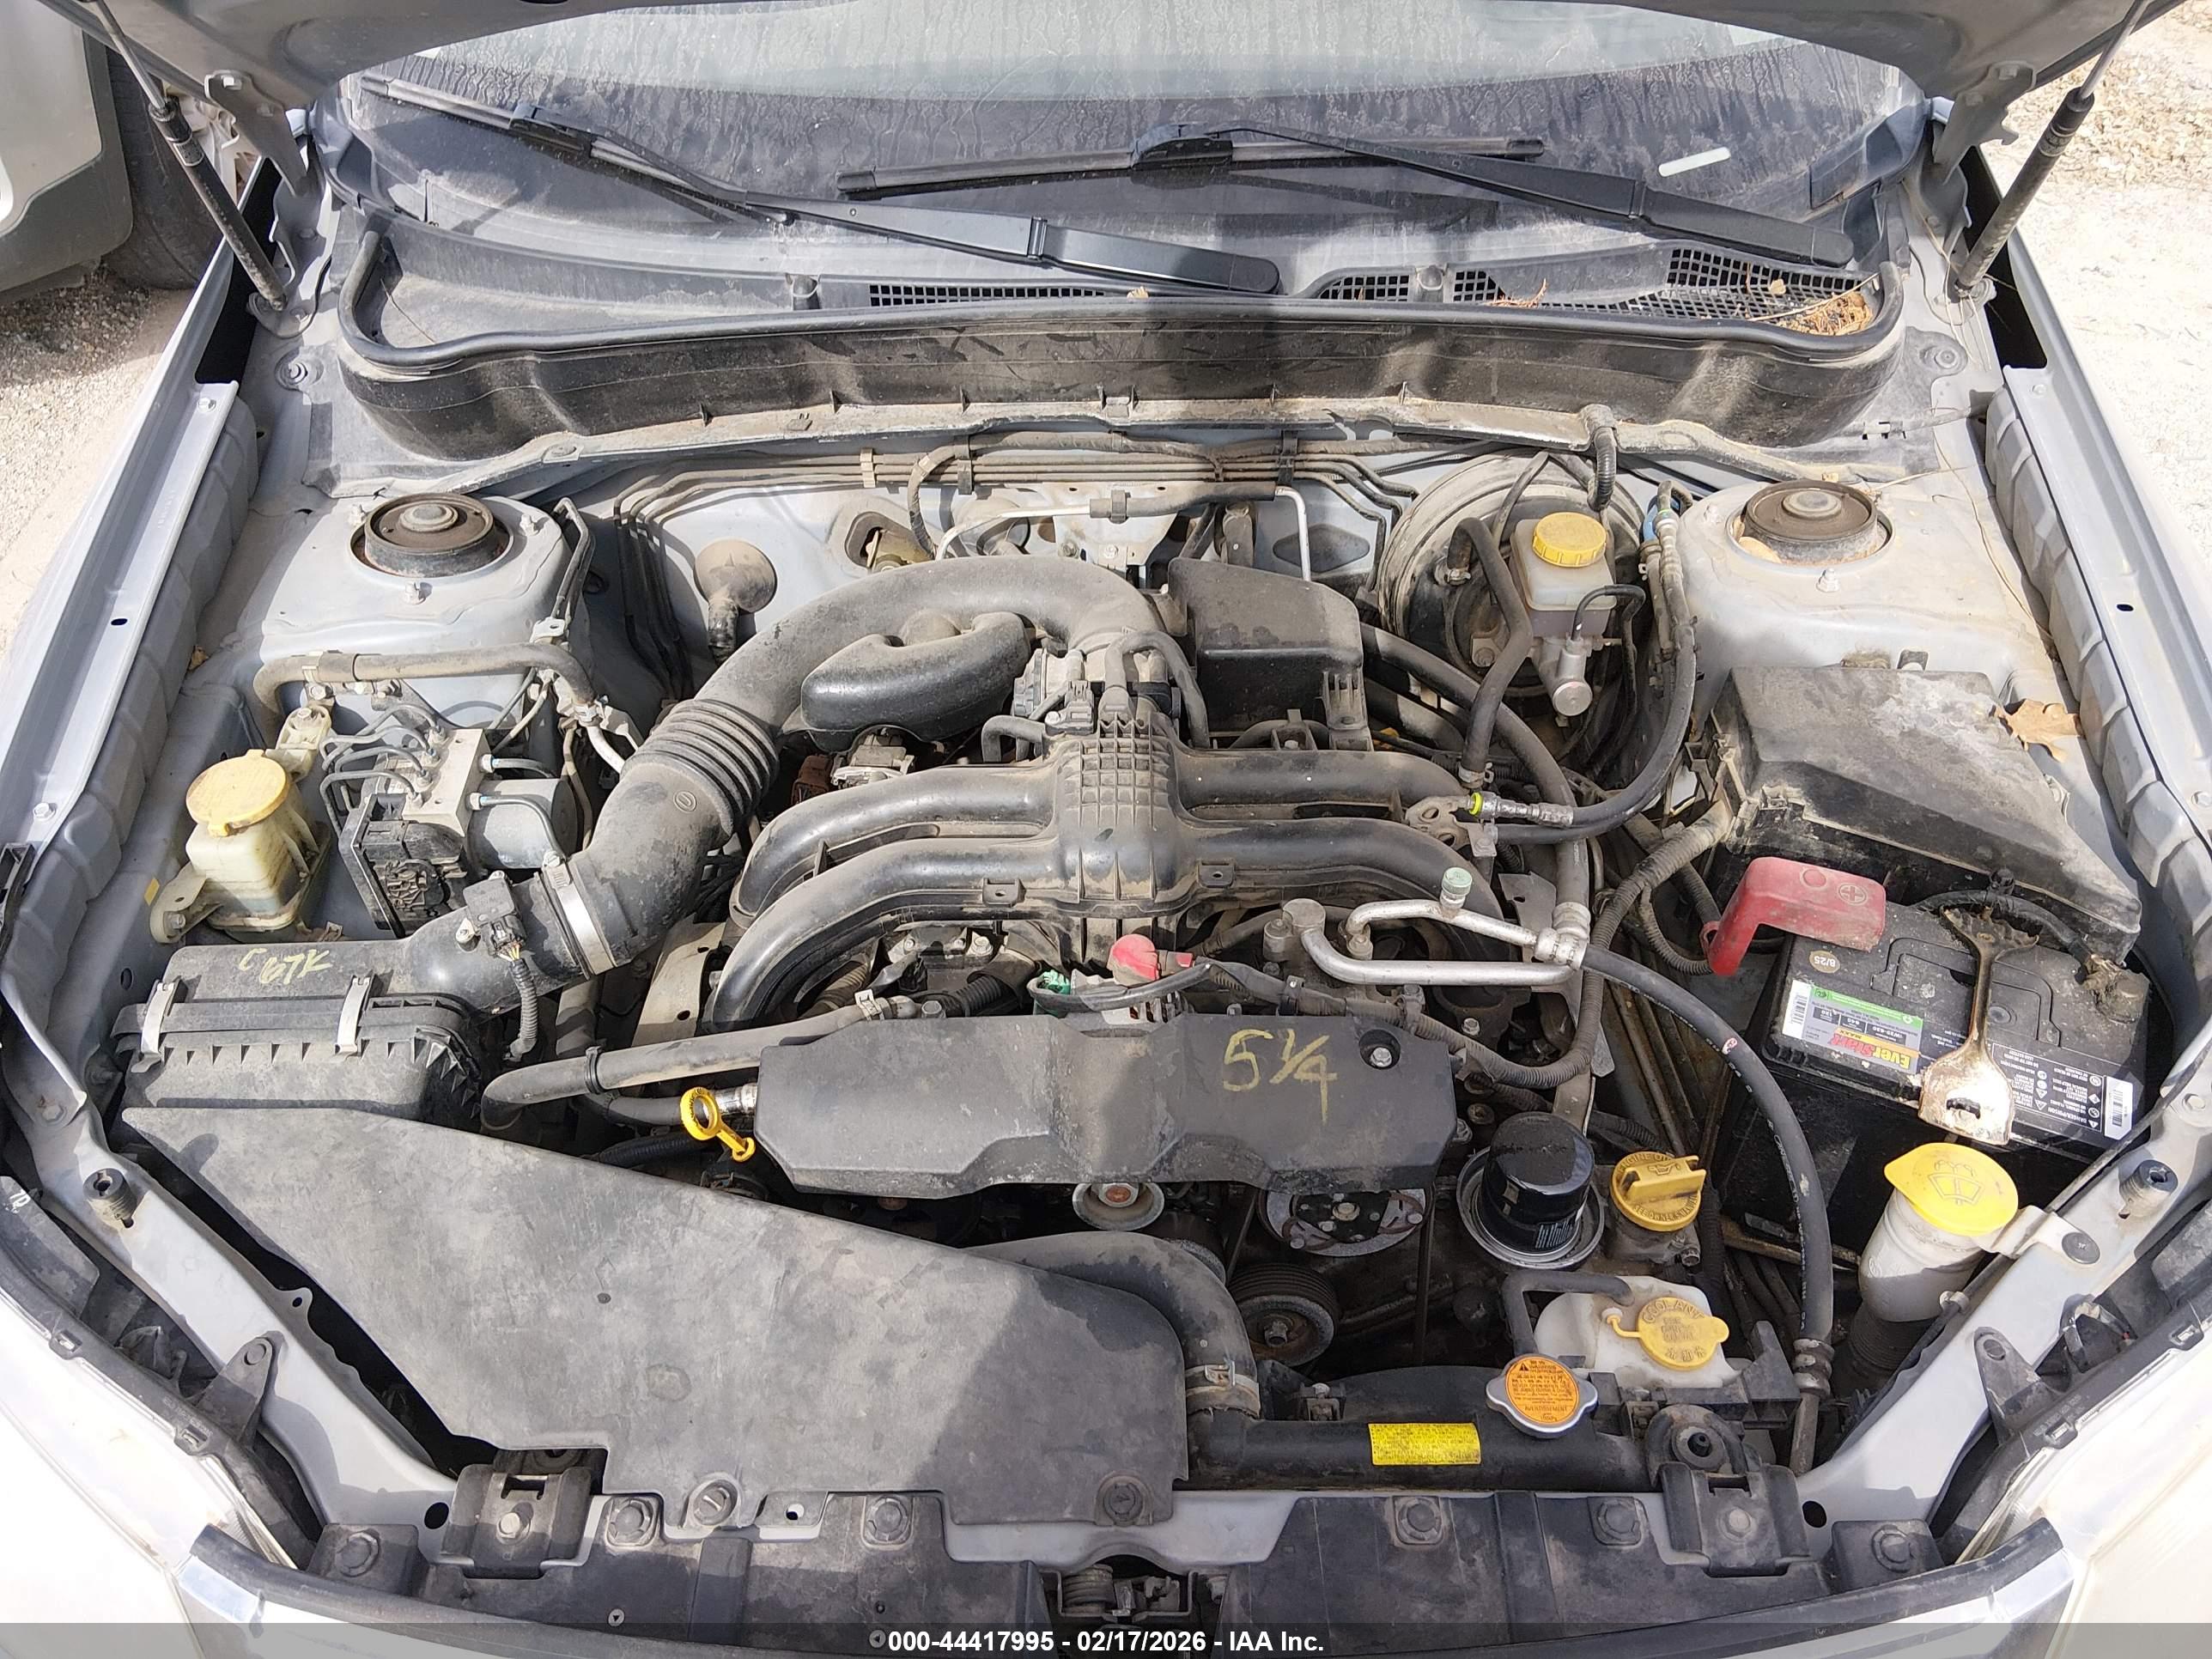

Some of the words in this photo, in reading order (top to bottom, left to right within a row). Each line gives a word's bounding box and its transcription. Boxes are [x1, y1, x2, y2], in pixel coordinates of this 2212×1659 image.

[1223, 1030, 1274, 1091] 5
[1827, 1031, 1911, 1069] EverStart
[1617, 1152, 1651, 1172] ENGINE
[1642, 1299, 1705, 1324] COOLANT
